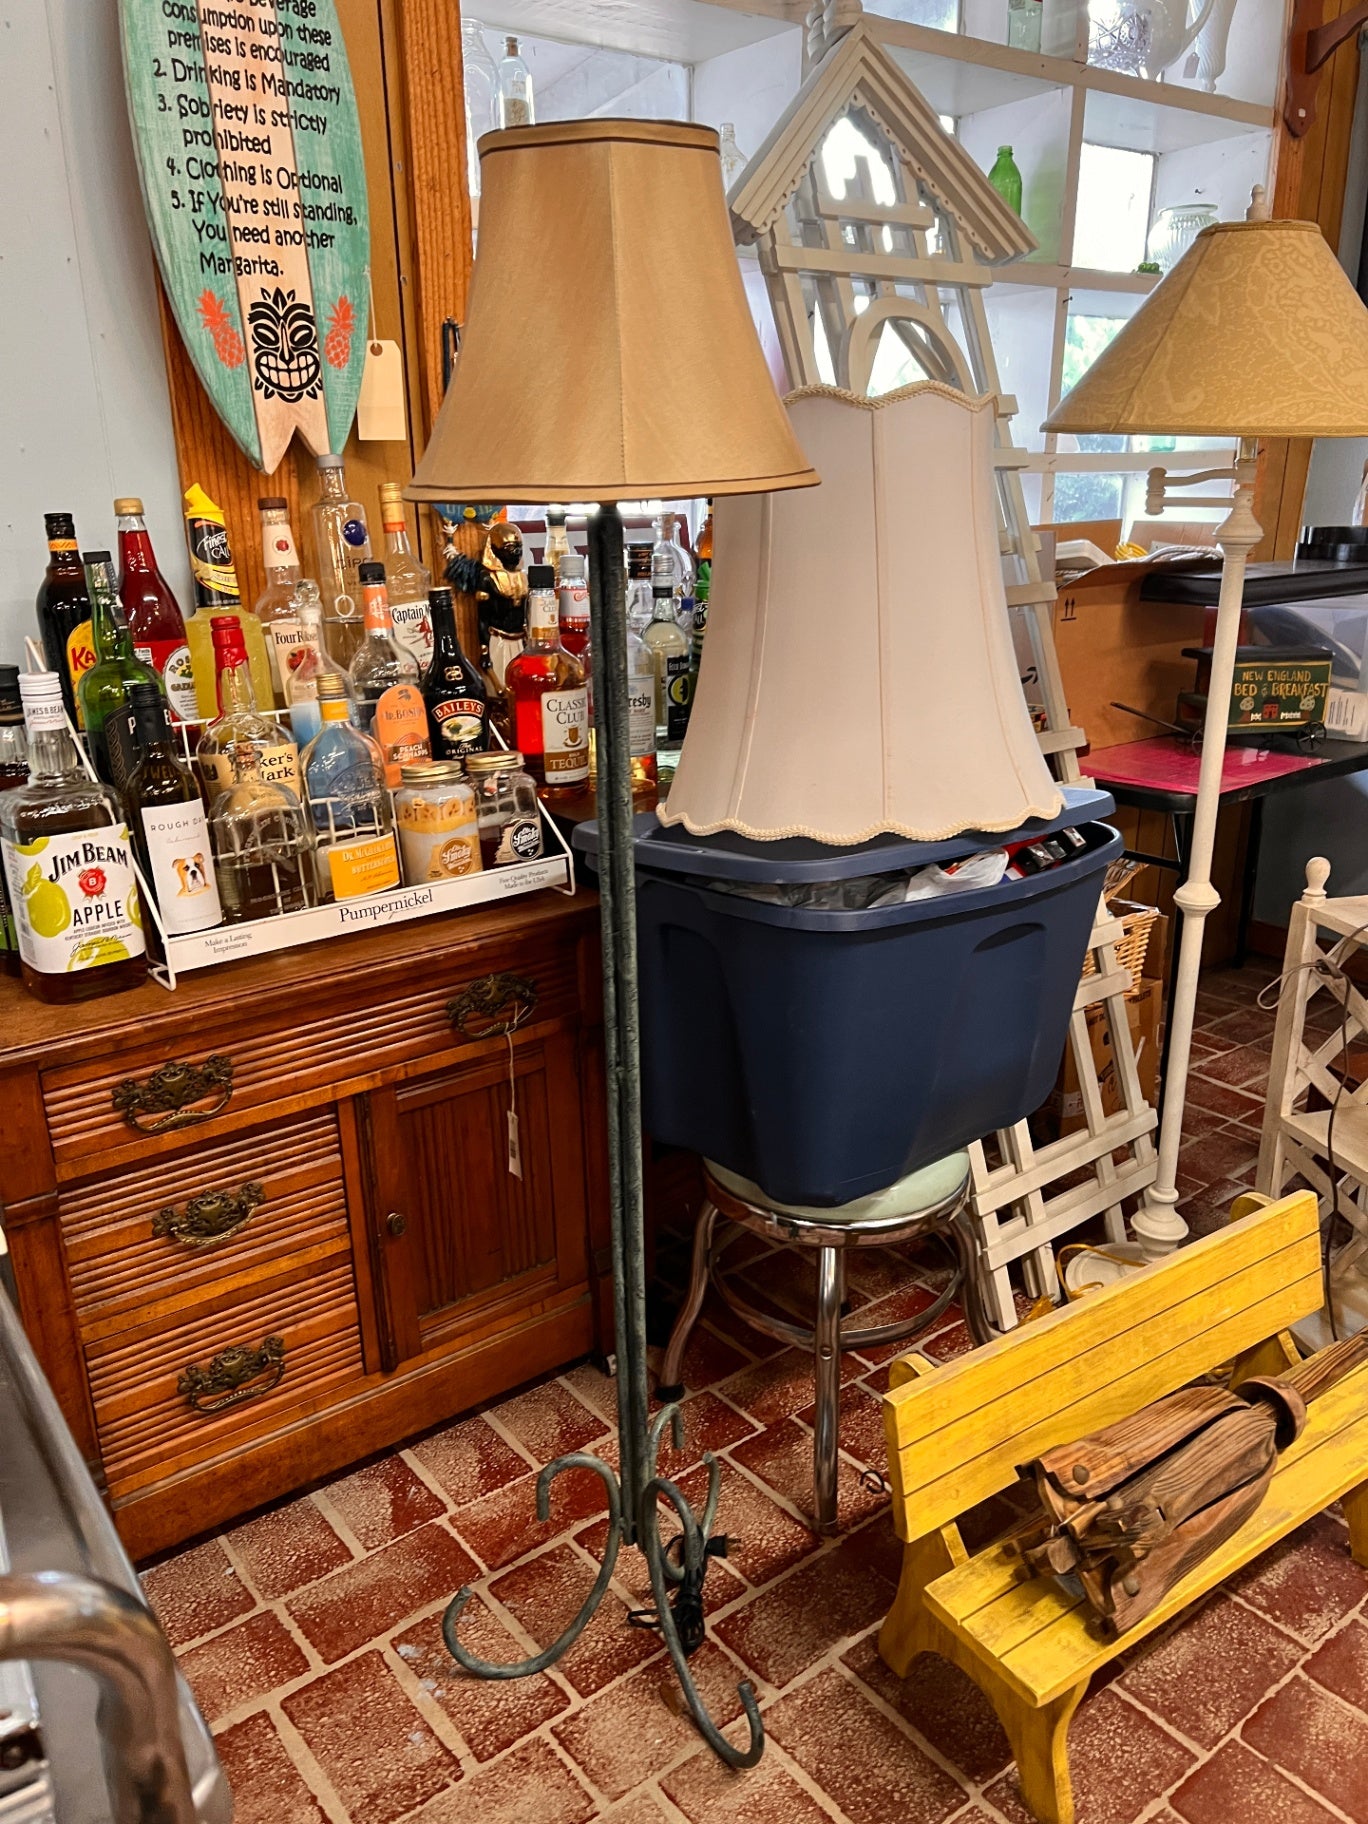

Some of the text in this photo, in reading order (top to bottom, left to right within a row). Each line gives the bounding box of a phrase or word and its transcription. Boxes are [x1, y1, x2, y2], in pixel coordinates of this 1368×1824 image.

[162, 1, 332, 46] consumption upon these
[168, 29, 330, 72] premises is encouraged
[172, 58, 241, 91] Drinking
[245, 70, 257, 91] is
[261, 72, 340, 105] Mandatory
[177, 93, 248, 124] Sobriety
[253, 105, 266, 126] is
[271, 107, 327, 135] strictly
[183, 128, 271, 155] prohibited
[186, 157, 256, 185] Clothing
[260, 164, 272, 185] is
[276, 167, 342, 194] Optional
[189, 190, 204, 213] If
[206, 190, 259, 216] You're
[263, 197, 289, 219] still
[293, 203, 357, 225] standing,
[192, 219, 335, 249] You need another
[200, 252, 284, 277] Margarita.
[392, 603, 425, 624] Captain
[275, 631, 296, 645] Four
[1242, 670, 1311, 682] NEW ENGLAND
[628, 692, 651, 709] resby
[1234, 683, 1257, 696] BED
[1271, 683, 1329, 699] BREAKFAST
[435, 702, 482, 717] BAILEYS
[393, 749, 428, 760] SCHNAPPS
[399, 743, 423, 753] PEACH
[446, 746, 483, 755] ORIGINAL
[260, 752, 293, 768] ker's
[262, 766, 295, 781] ark
[151, 821, 188, 831] ROUGH
[48, 842, 129, 883] JIM BEAM
[73, 900, 123, 927] APPLE
[339, 889, 433, 922] Pumpernickel
